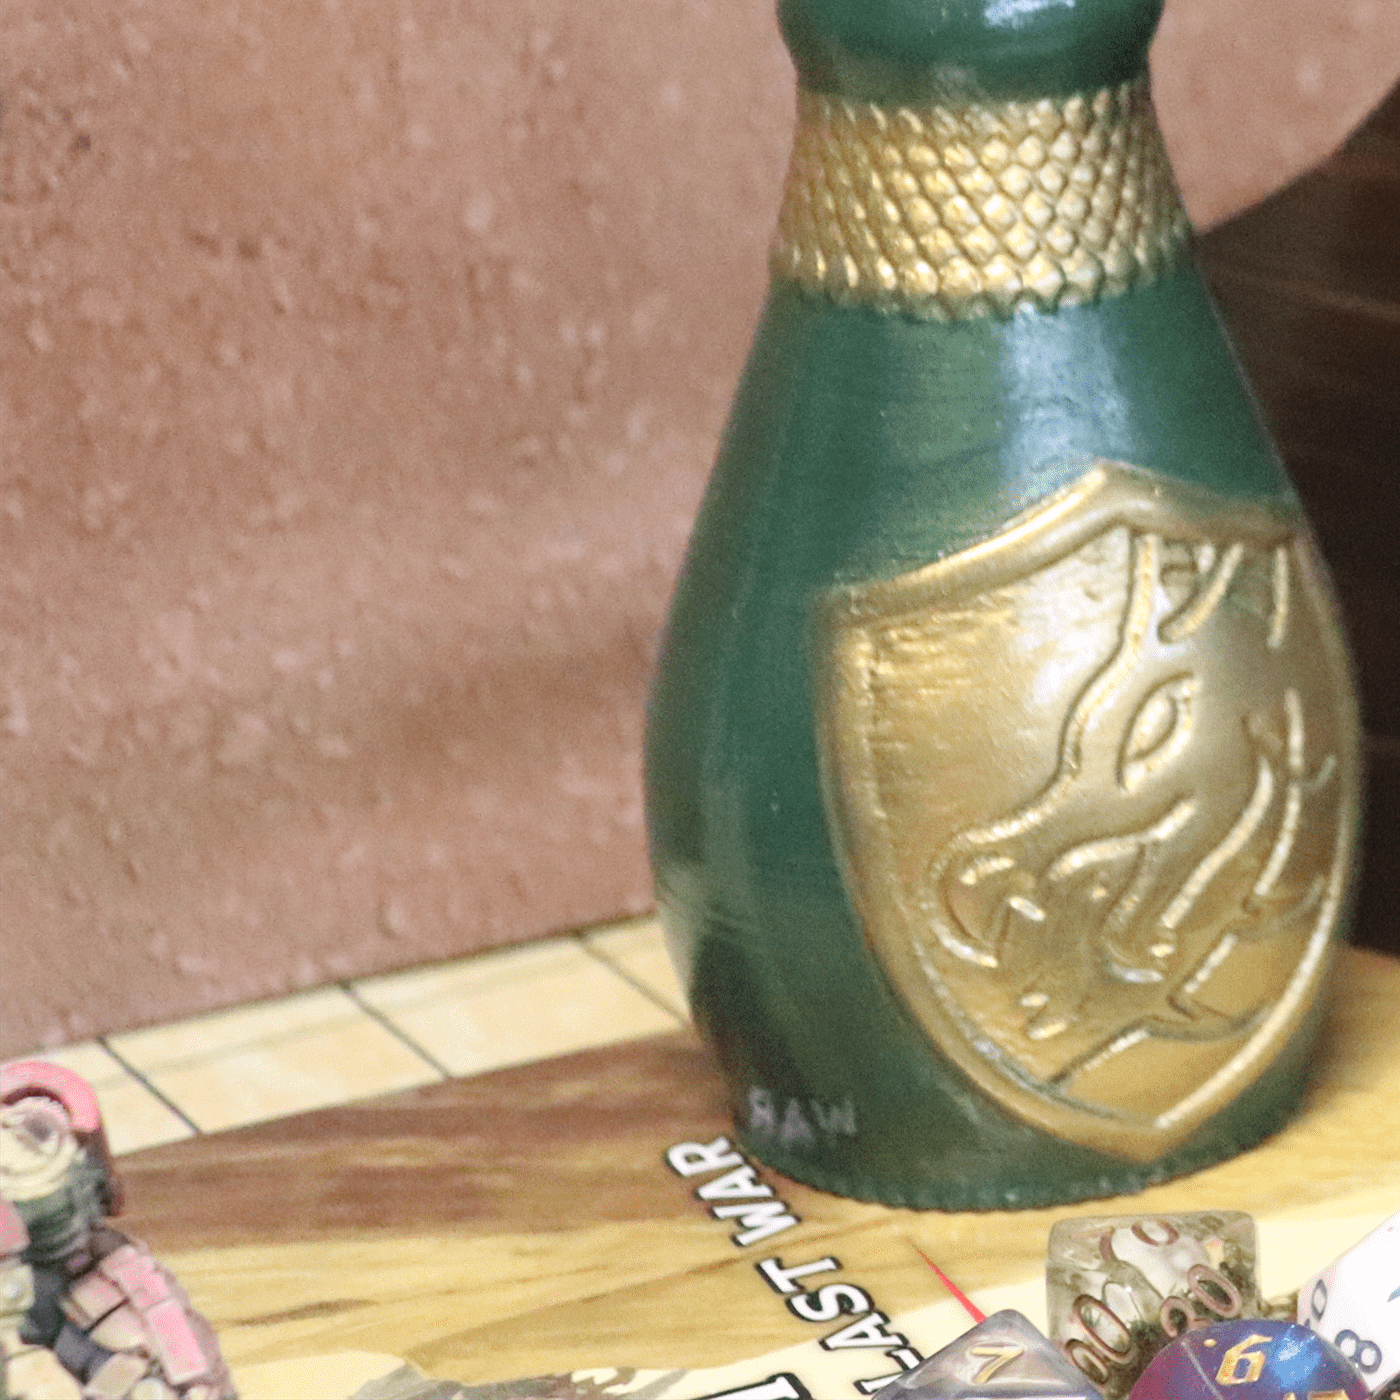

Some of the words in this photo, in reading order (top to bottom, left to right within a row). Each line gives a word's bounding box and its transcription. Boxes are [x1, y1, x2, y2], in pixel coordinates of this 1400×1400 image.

[663, 1134, 802, 1248] WAR
[964, 1343, 1027, 1386] 7
[1334, 1329, 1383, 1375] 8
